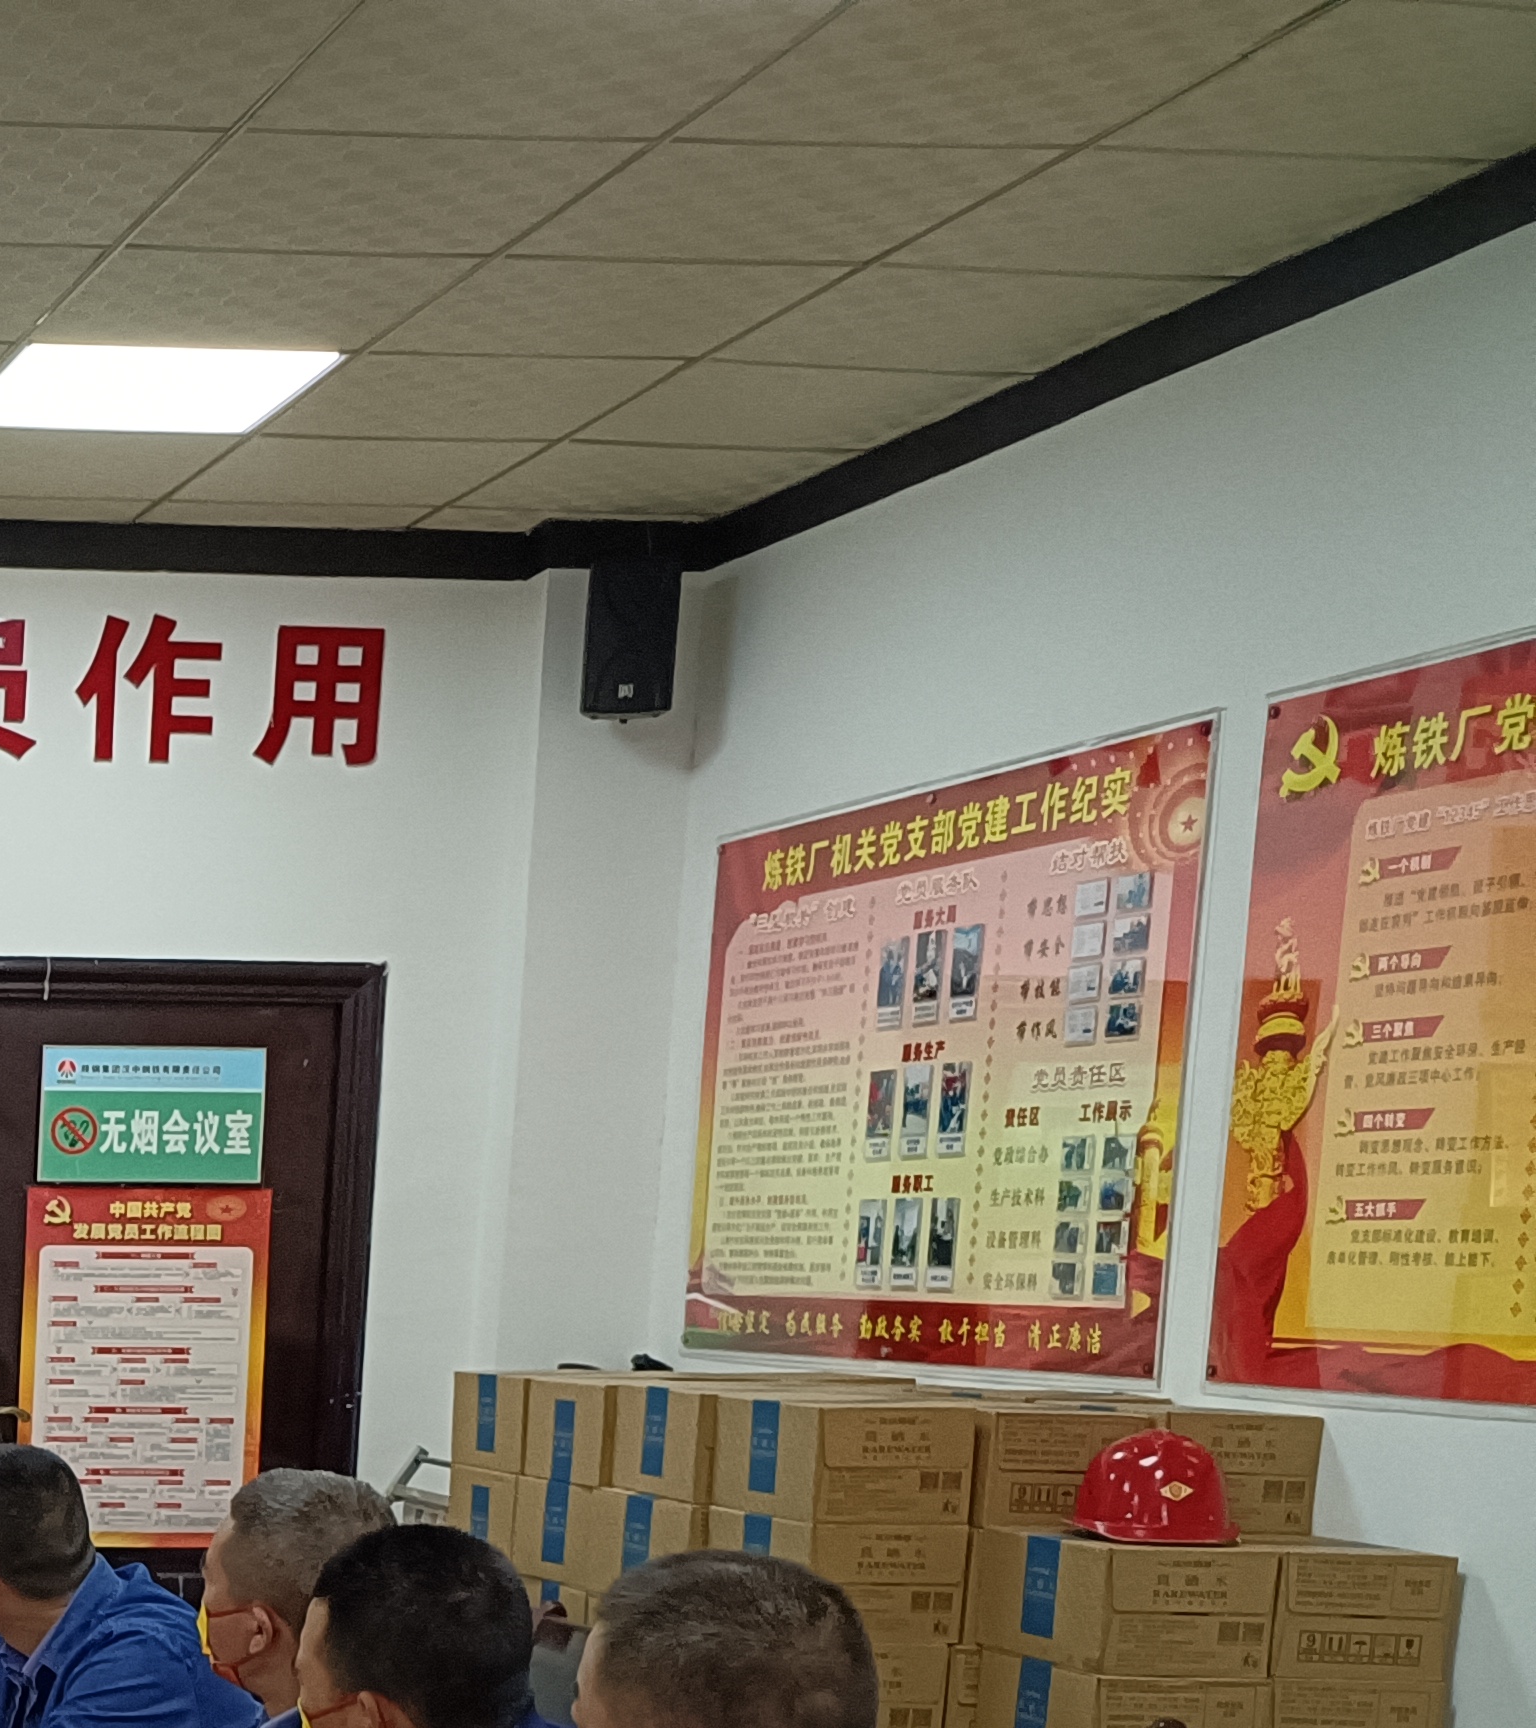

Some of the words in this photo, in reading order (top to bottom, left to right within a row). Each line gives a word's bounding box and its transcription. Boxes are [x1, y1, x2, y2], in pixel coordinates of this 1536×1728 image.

[1370, 693, 1536, 779] 炼铁厂党
[762, 767, 1133, 893] 炼铁厂机关党支部党建工作纪实
[1032, 1062, 1126, 1090] 党员责任区
[1004, 1106, 1041, 1128] 责任区
[1078, 1100, 1132, 1122] 工作展示
[98, 1109, 254, 1156] 无烟会议室
[891, 1174, 934, 1194] 服务职工
[989, 1187, 1045, 1207] 生产技术科
[108, 1200, 193, 1219] 中国共产党
[72, 1223, 223, 1242] 发展党员工作流程图
[986, 1230, 1042, 1250] 设备管理科
[982, 1272, 1038, 1291] 安全环保科
[858, 1314, 923, 1344] 勤政务实
[938, 1318, 1007, 1349] 敢于担当
[1028, 1320, 1102, 1355] 清正廉洁
